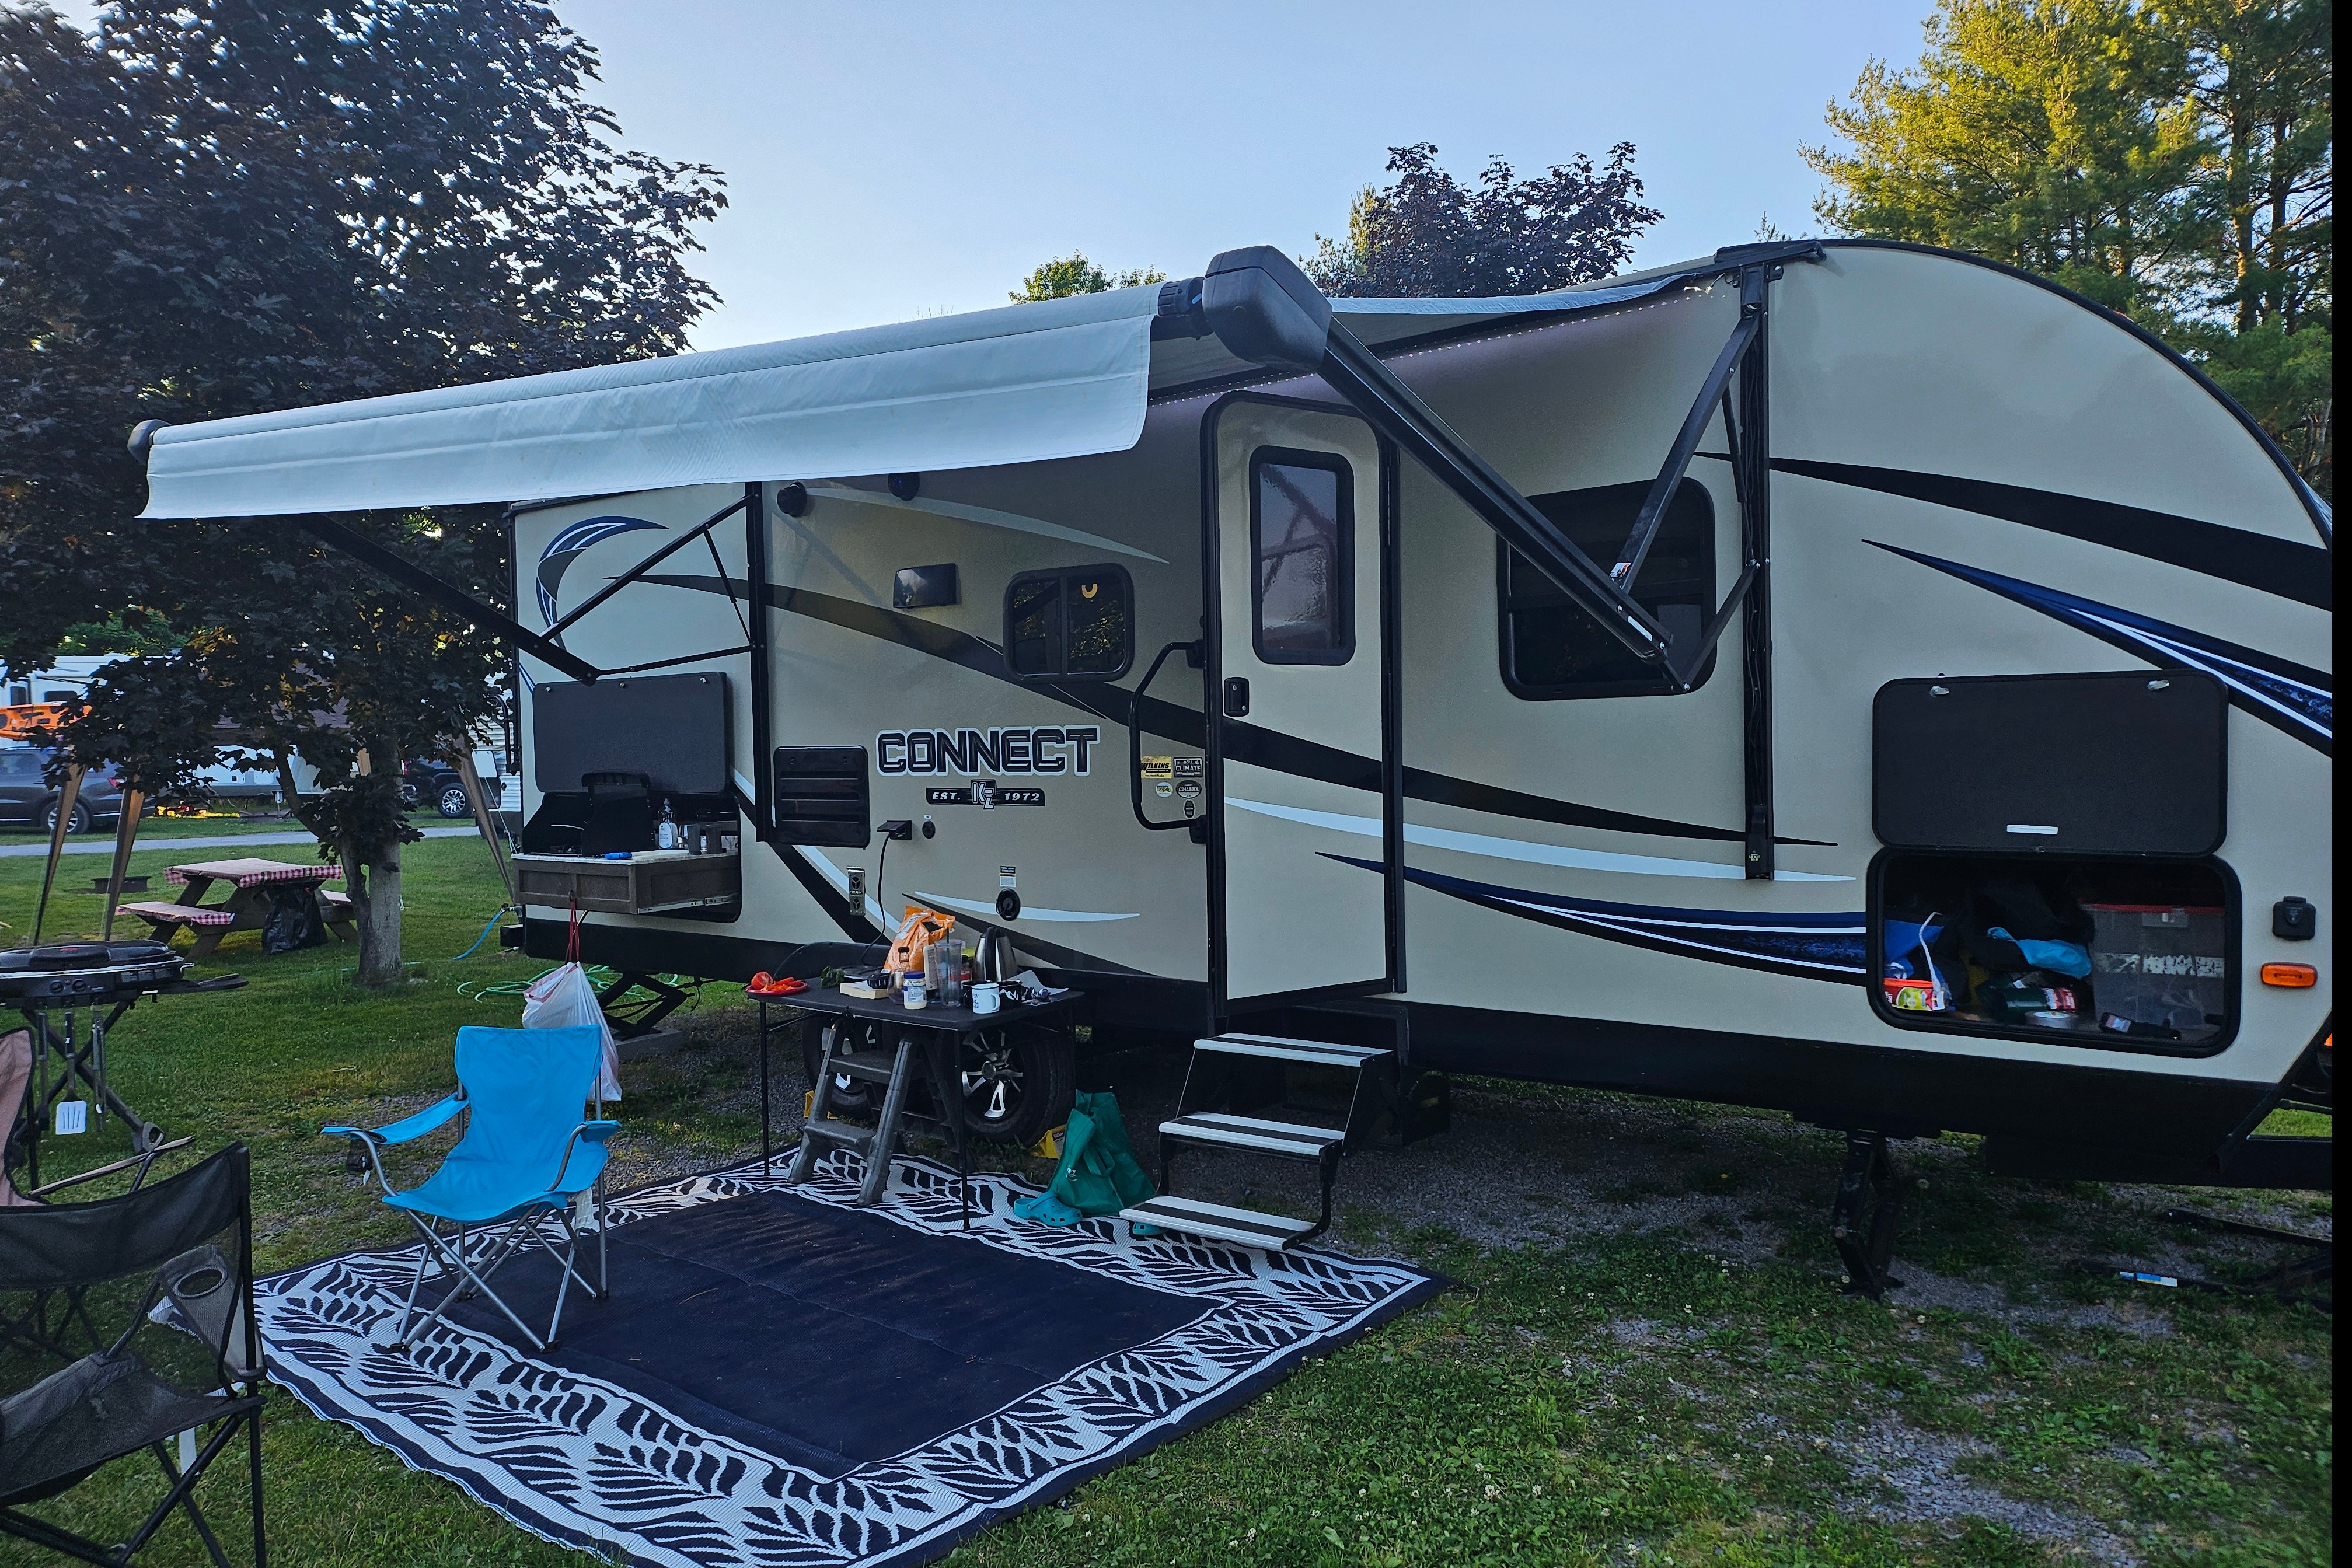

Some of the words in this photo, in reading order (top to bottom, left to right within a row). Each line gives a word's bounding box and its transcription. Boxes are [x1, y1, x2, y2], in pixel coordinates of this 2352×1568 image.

[875, 725, 1101, 776] CONNECT
[1141, 763, 1170, 771] WILKINS
[933, 792, 961, 801] EST.
[1004, 792, 1040, 801] 1972
